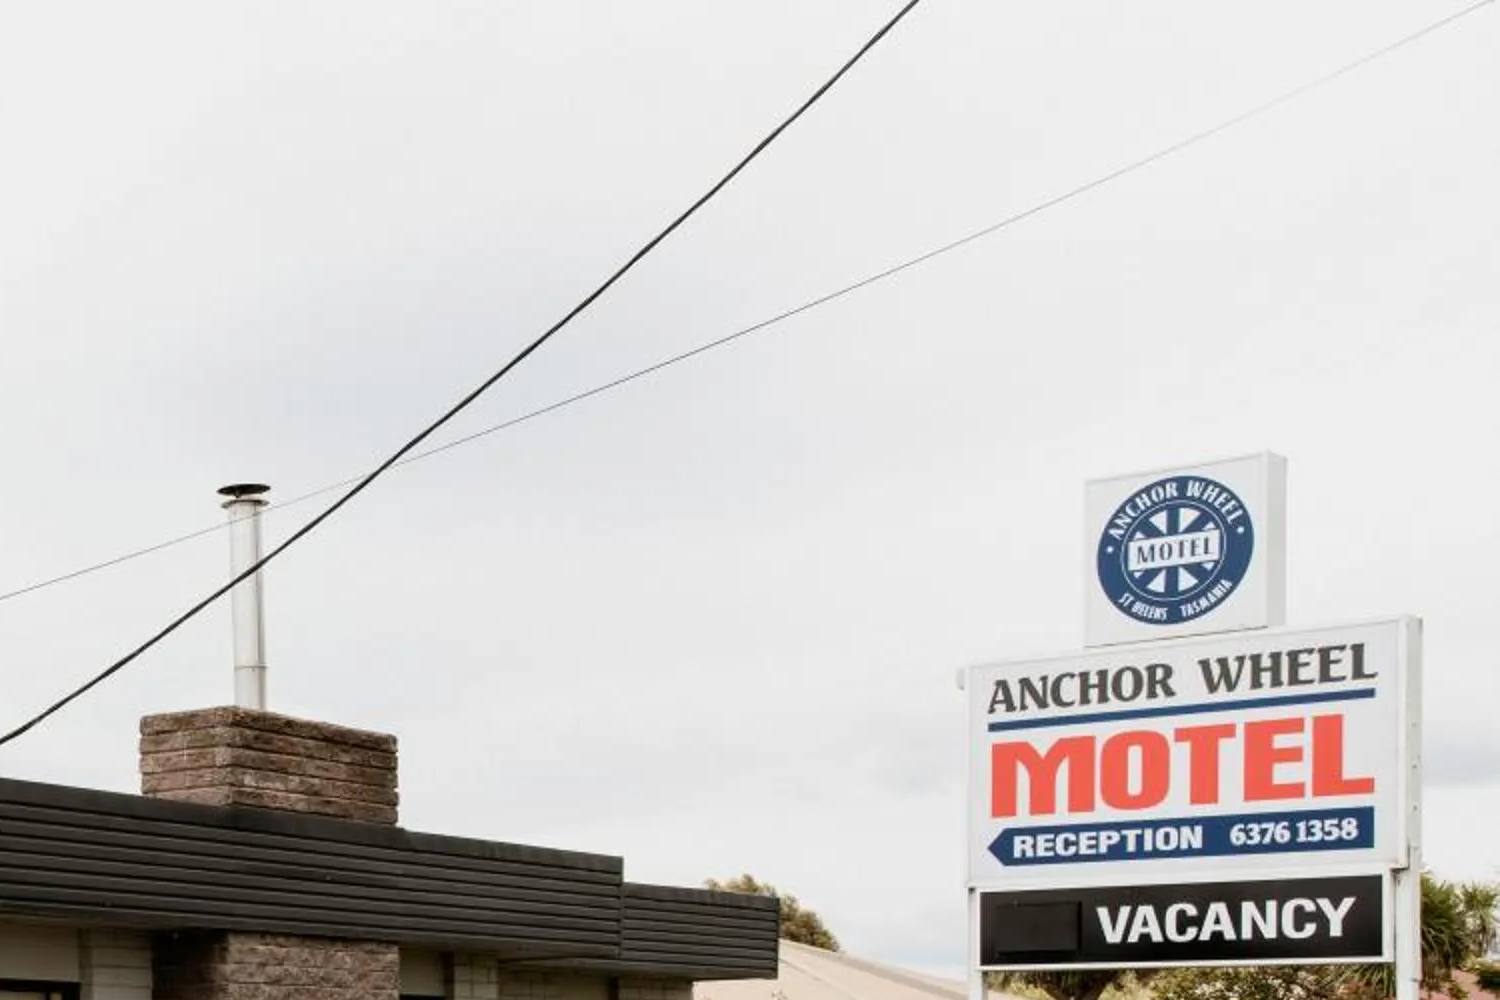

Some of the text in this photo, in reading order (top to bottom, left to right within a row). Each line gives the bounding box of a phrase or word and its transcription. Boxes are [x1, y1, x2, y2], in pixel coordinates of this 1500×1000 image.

[1108, 479, 1244, 541] ANCHOR WHEEL
[1136, 535, 1215, 565] MOTEL
[1118, 578, 1233, 621] ST HELENS TASMANIA
[987, 642, 1378, 715] ANCHOR WHEEL
[990, 713, 1375, 819] MOTEL
[1012, 816, 1359, 859] RECEPTION 6376 1358
[1096, 896, 1357, 945] VACANCY
